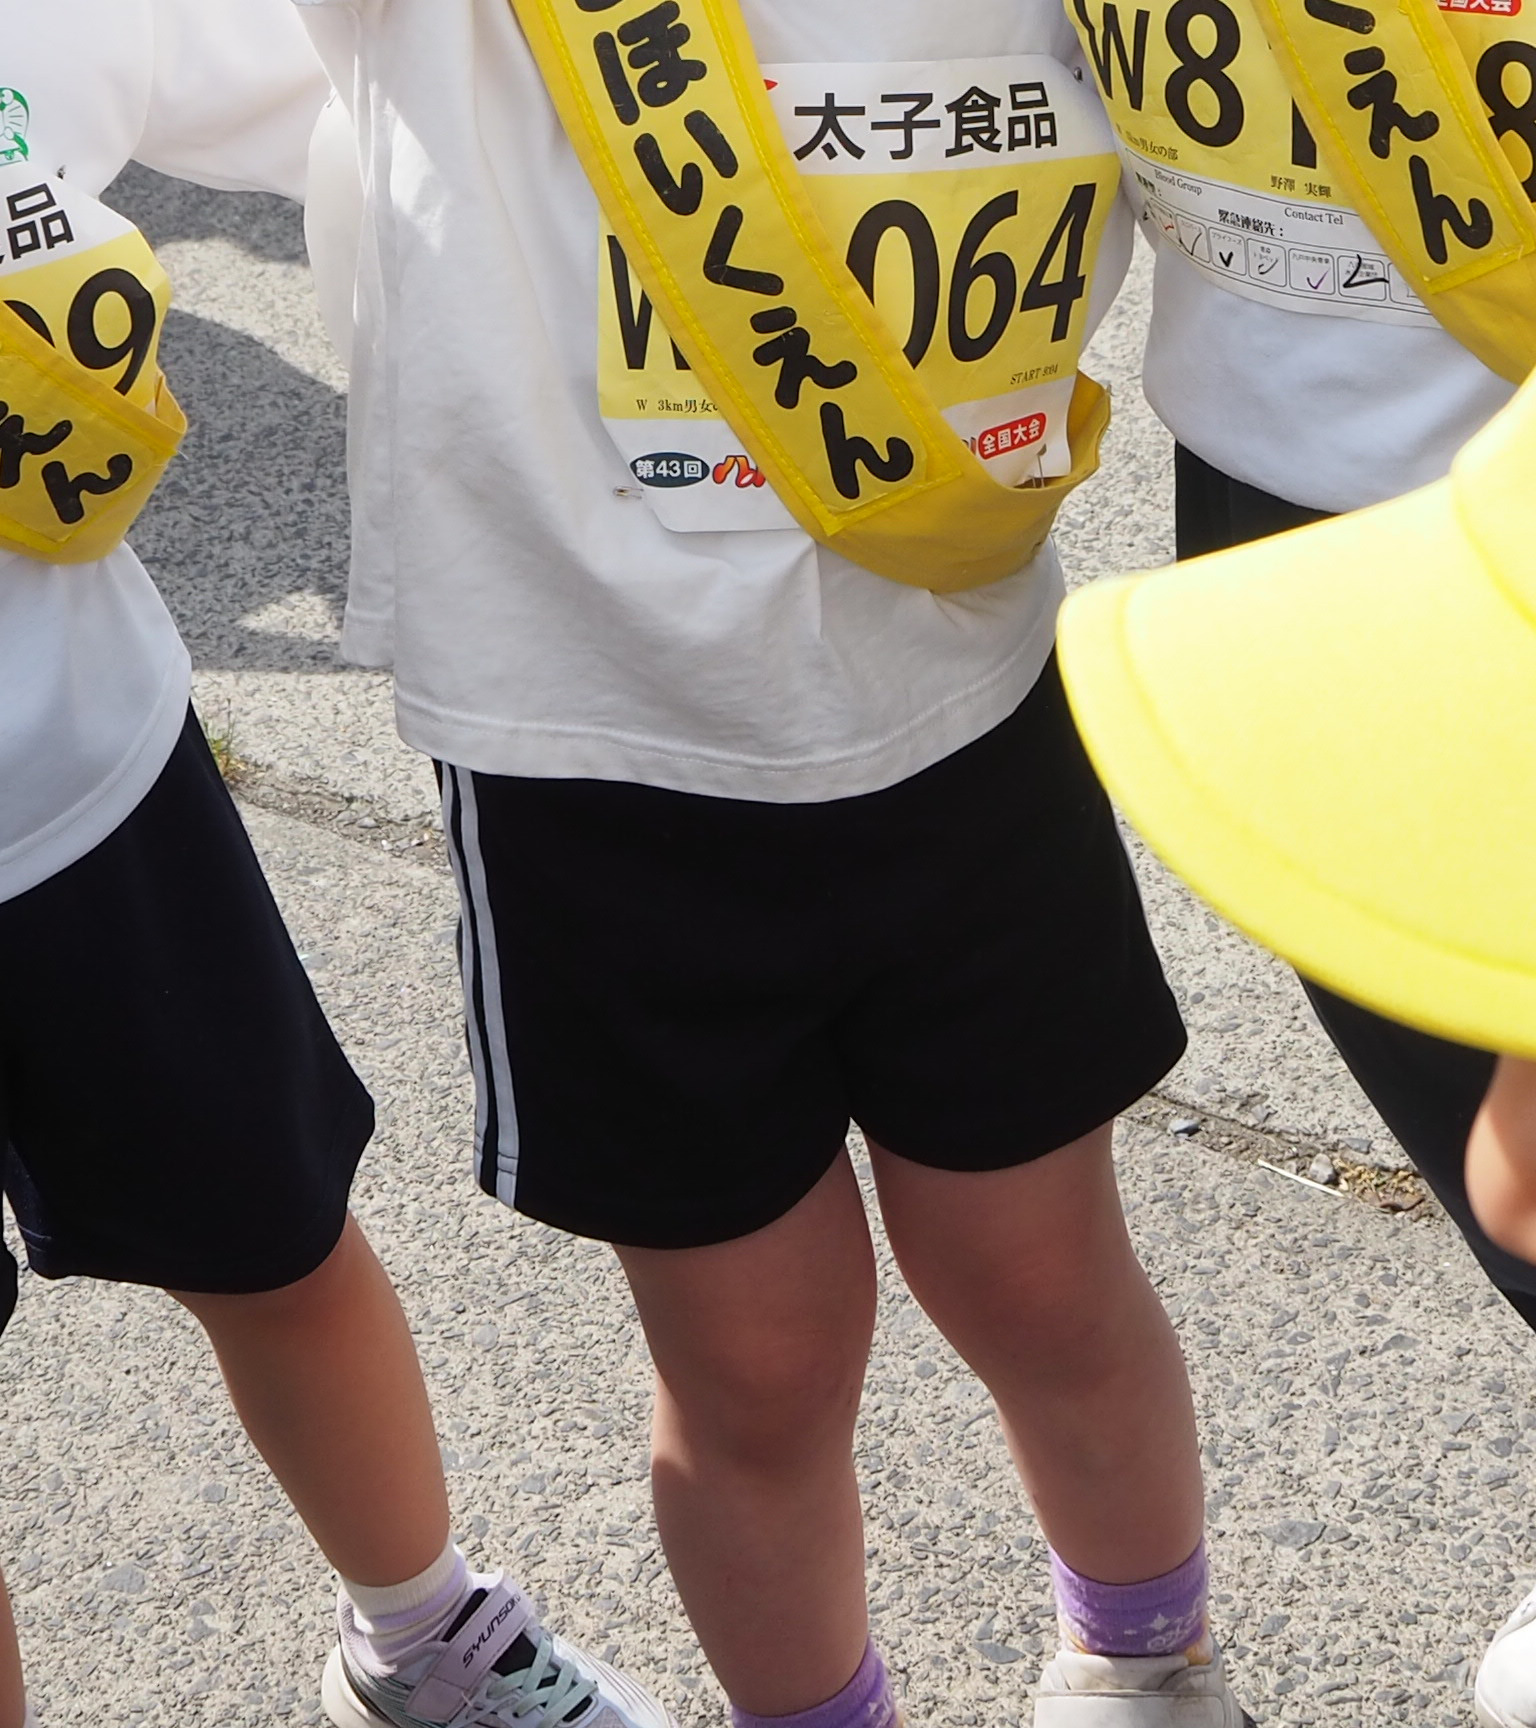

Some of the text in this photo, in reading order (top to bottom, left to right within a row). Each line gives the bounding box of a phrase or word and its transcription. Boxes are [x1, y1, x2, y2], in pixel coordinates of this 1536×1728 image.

[792, 80, 1059, 163] 太子食品
[1176, 177, 1203, 197] Group
[1284, 207, 1344, 226] Contact Tel
[1010, 367, 1041, 385] START
[636, 398, 719, 413] W 3km男女
[981, 417, 1041, 455] 全国大会
[635, 458, 703, 479] 第43回
